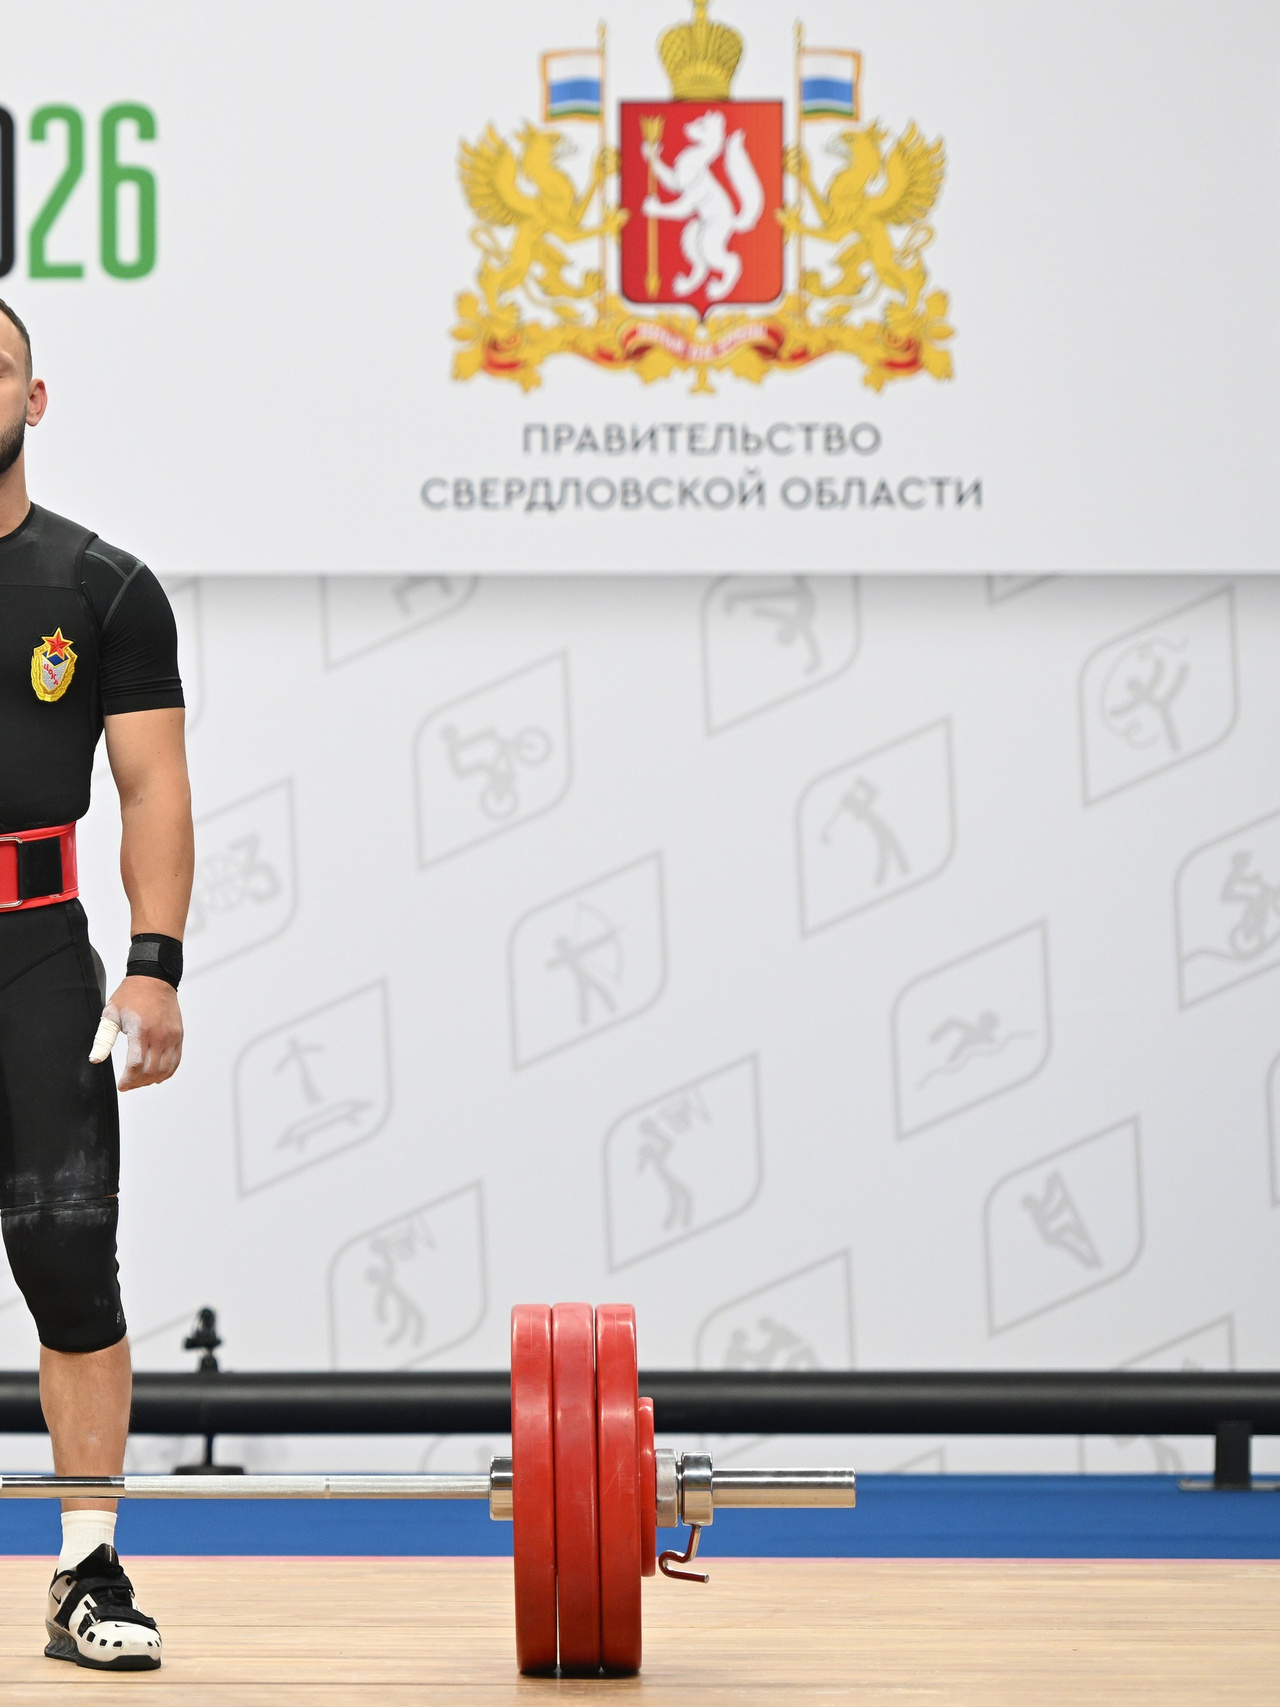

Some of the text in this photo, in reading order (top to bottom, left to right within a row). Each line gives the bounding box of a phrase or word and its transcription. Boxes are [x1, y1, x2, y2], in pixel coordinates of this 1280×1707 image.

[522, 422, 883, 457] ПРАВИТЕЛЬСТВО
[420, 469, 985, 513] СВЕРДЛОВСКОЙ ОБЛАСТИ
